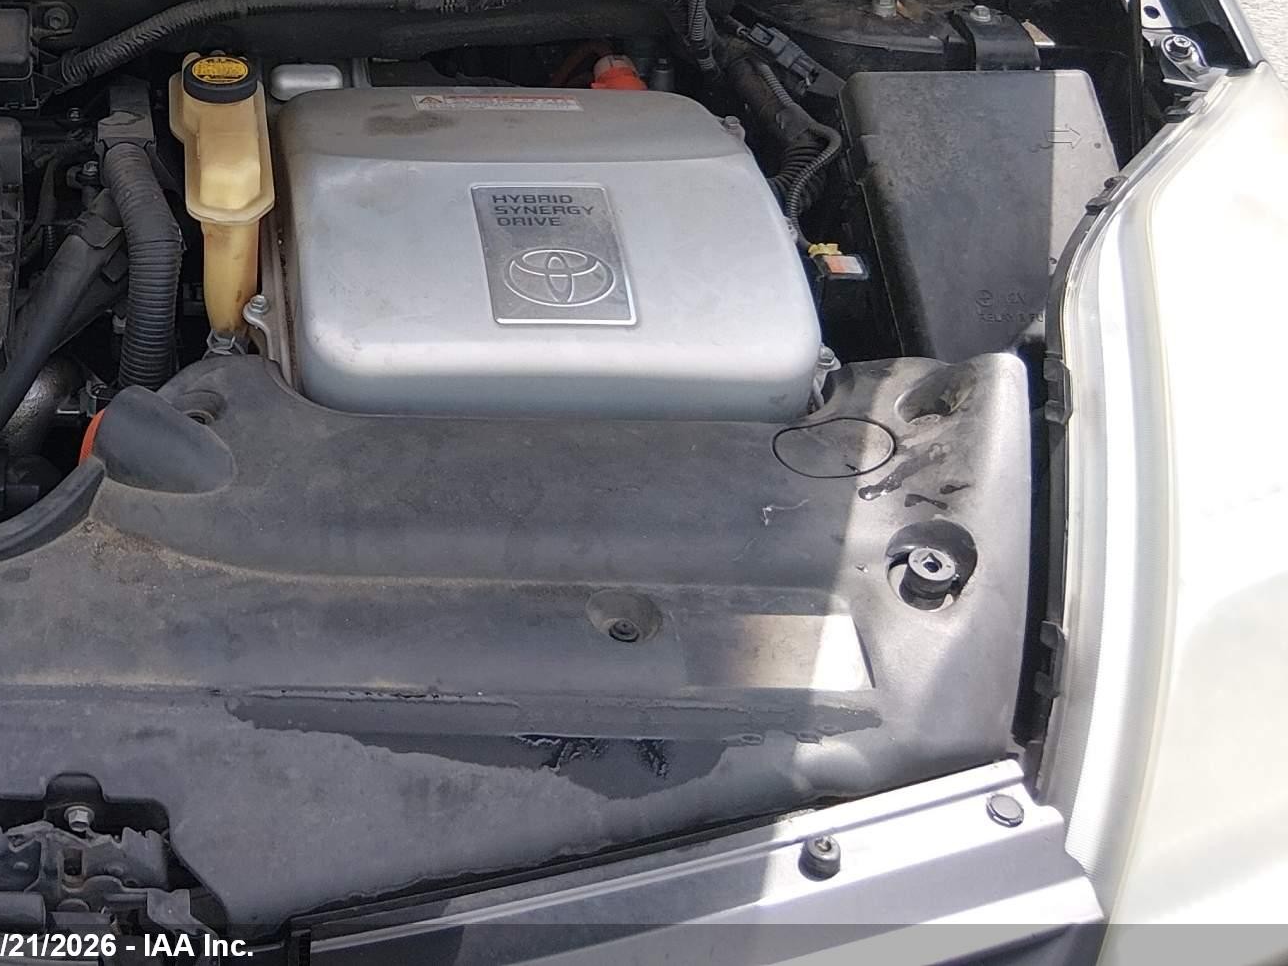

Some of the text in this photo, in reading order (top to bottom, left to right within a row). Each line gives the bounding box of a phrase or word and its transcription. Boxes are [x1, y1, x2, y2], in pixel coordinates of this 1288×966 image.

[492, 194, 573, 204] HYBRID
[494, 205, 594, 216] SYNERGY
[496, 216, 562, 227] DRIVE
